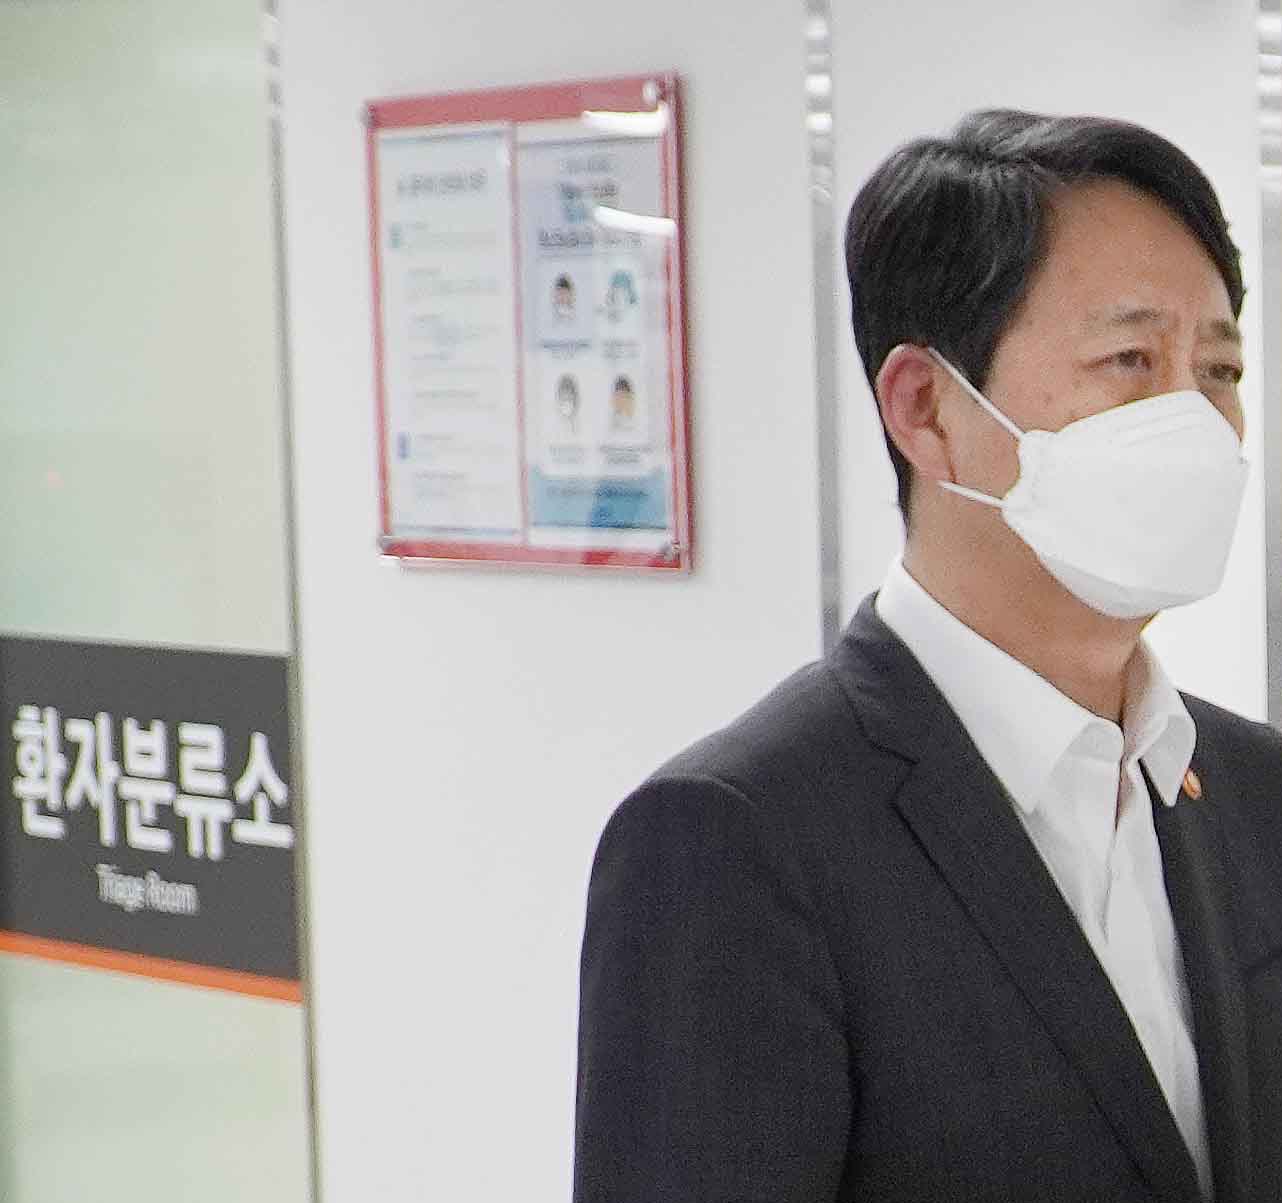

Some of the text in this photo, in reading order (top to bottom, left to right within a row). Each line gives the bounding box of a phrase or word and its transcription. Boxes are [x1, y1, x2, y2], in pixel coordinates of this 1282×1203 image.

[12, 703, 296, 861] 환자분류소
[95, 862, 200, 915] Triage Room
